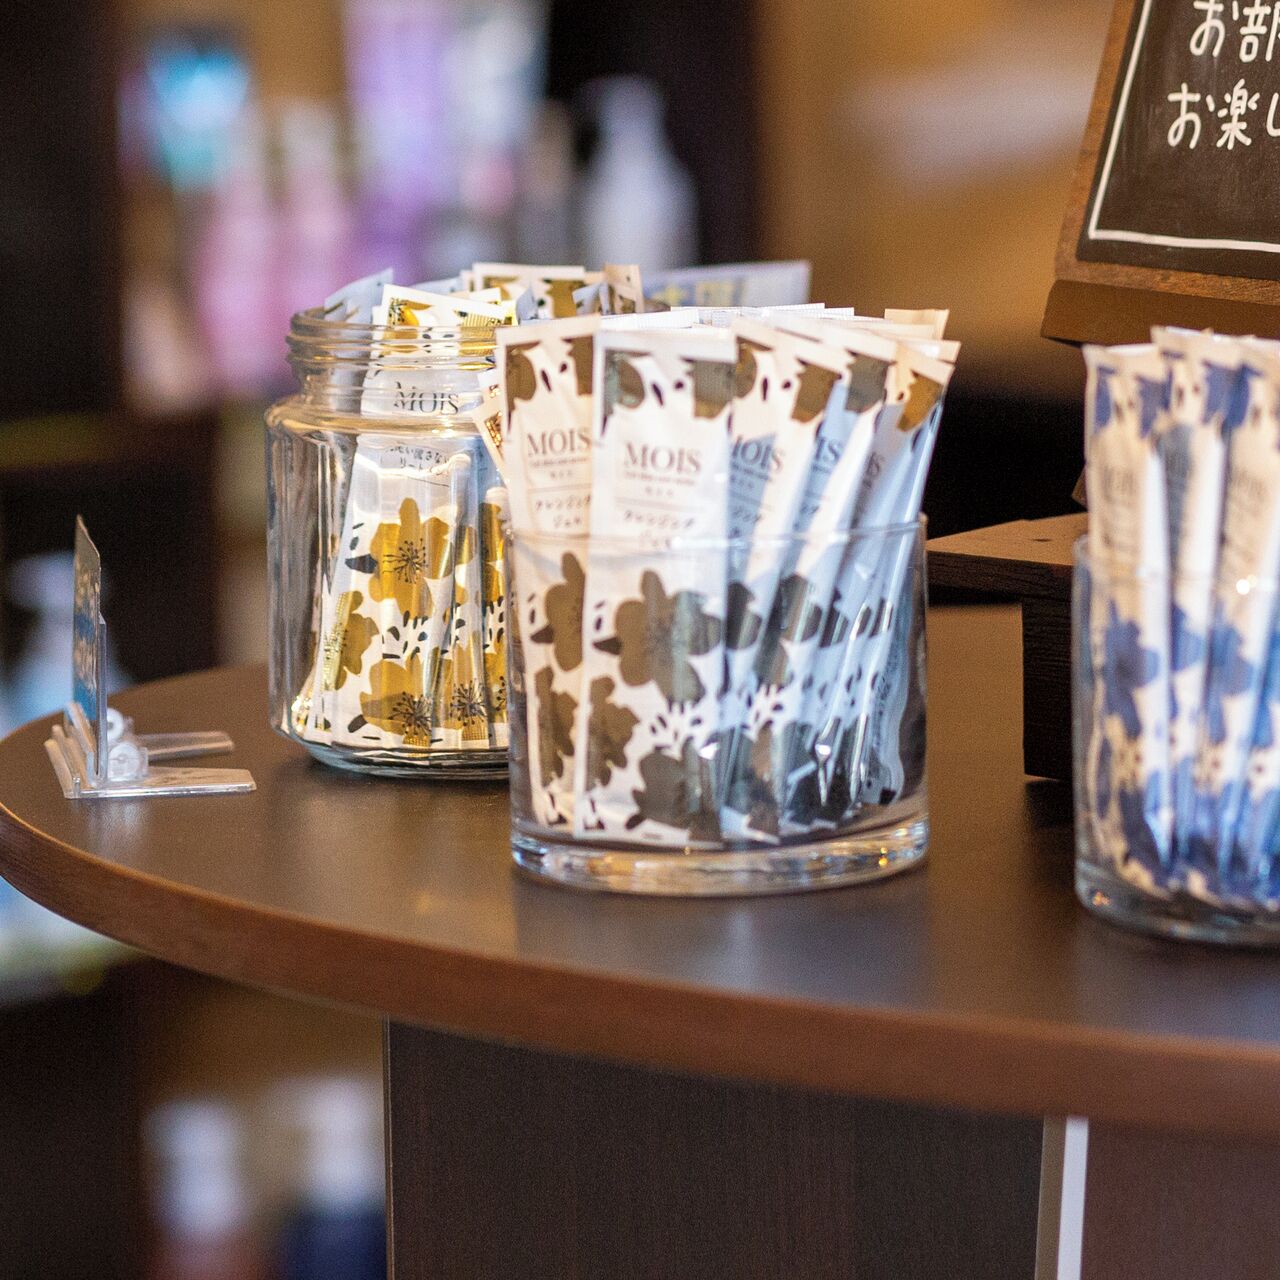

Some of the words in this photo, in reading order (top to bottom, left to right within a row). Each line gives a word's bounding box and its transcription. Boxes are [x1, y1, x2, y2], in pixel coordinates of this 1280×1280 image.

[394, 381, 460, 416] MOIS
[527, 427, 591, 456] MOIS
[625, 442, 702, 474] MOIS
